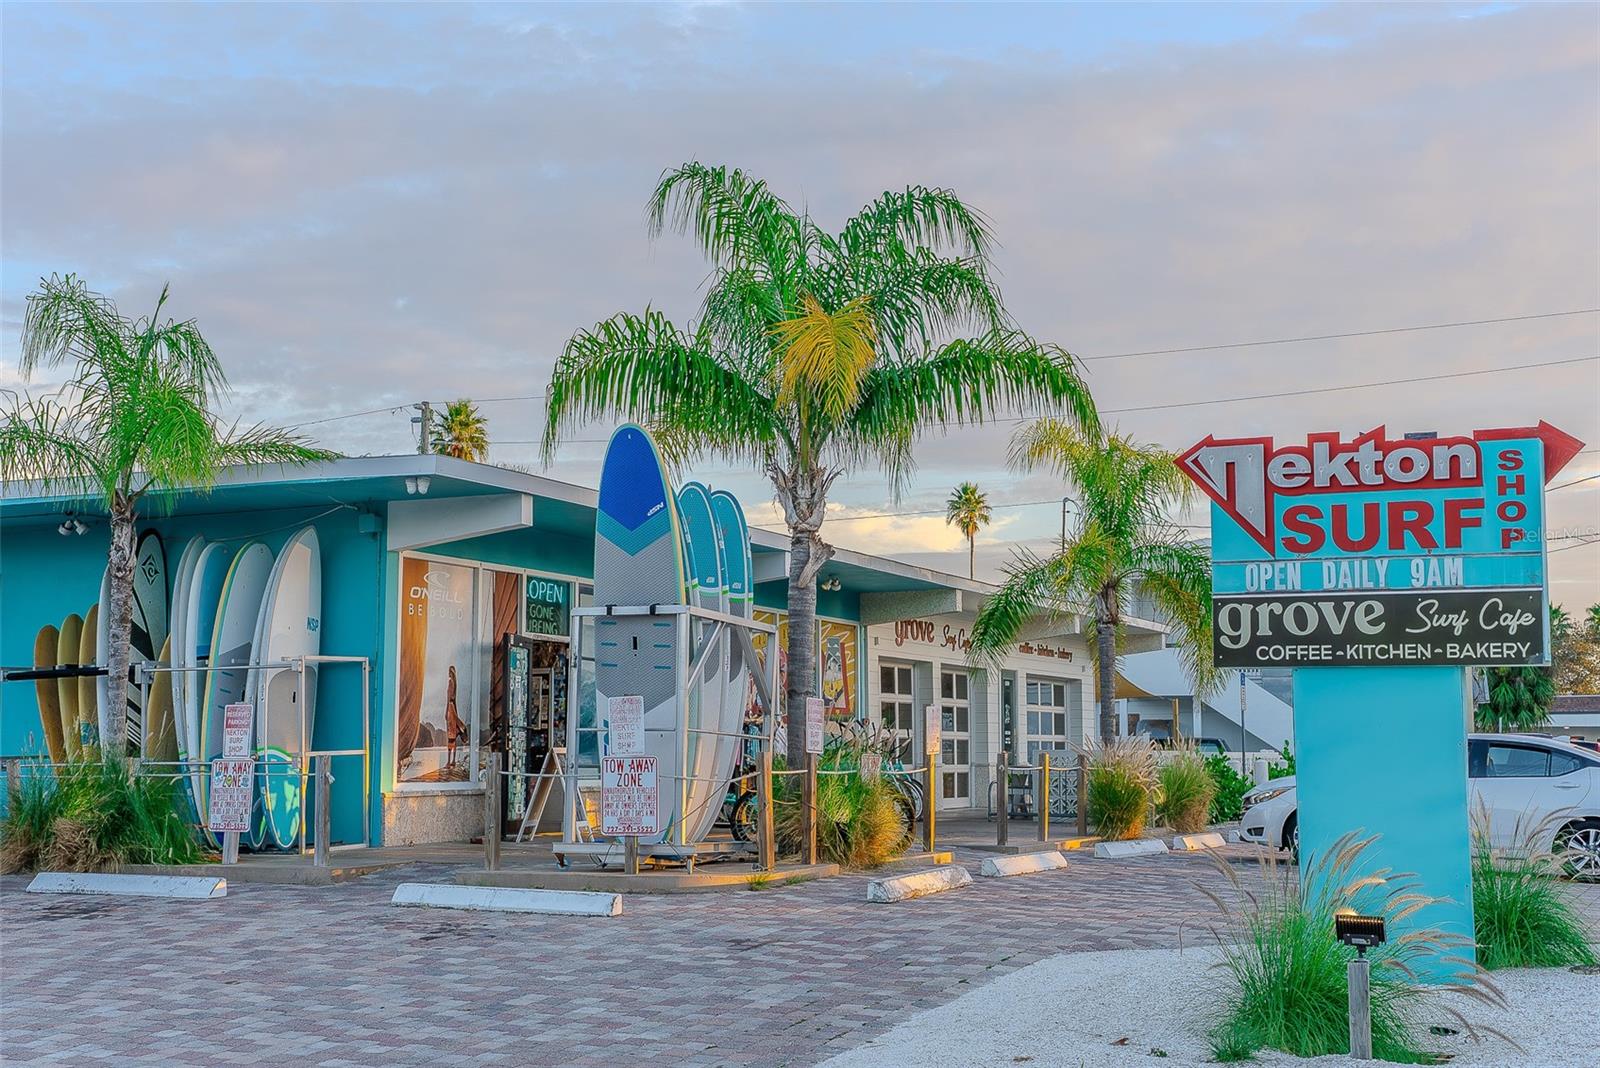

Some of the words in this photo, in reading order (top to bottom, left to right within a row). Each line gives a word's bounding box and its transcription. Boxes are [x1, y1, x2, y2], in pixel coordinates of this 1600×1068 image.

[1496, 449, 1528, 550] SHOP
[1282, 499, 1485, 554] SURF
[1245, 562, 1301, 592] OPEN
[1322, 559, 1389, 590] DAILY
[1410, 557, 1464, 587] 9AM
[529, 579, 563, 604] OPEN
[408, 603, 423, 616] BE
[529, 603, 554, 621] GONE
[306, 616, 320, 632] NSP
[527, 619, 558, 635] URFING
[1217, 600, 1387, 650] grove
[1405, 599, 1471, 636] Surf
[1477, 597, 1536, 636] Cafe
[894, 619, 935, 648] grove
[1256, 644, 1334, 661] COFFEE
[1345, 643, 1432, 660] KITCHEN
[1446, 641, 1532, 660] BAKERY
[229, 736, 244, 744] SURF
[617, 731, 636, 740] SURF
[213, 762, 229, 775] TOW
[232, 761, 252, 774] AWAY
[604, 759, 625, 773] TOW
[629, 758, 655, 773] AWAY
[616, 773, 643, 787] ZONE
